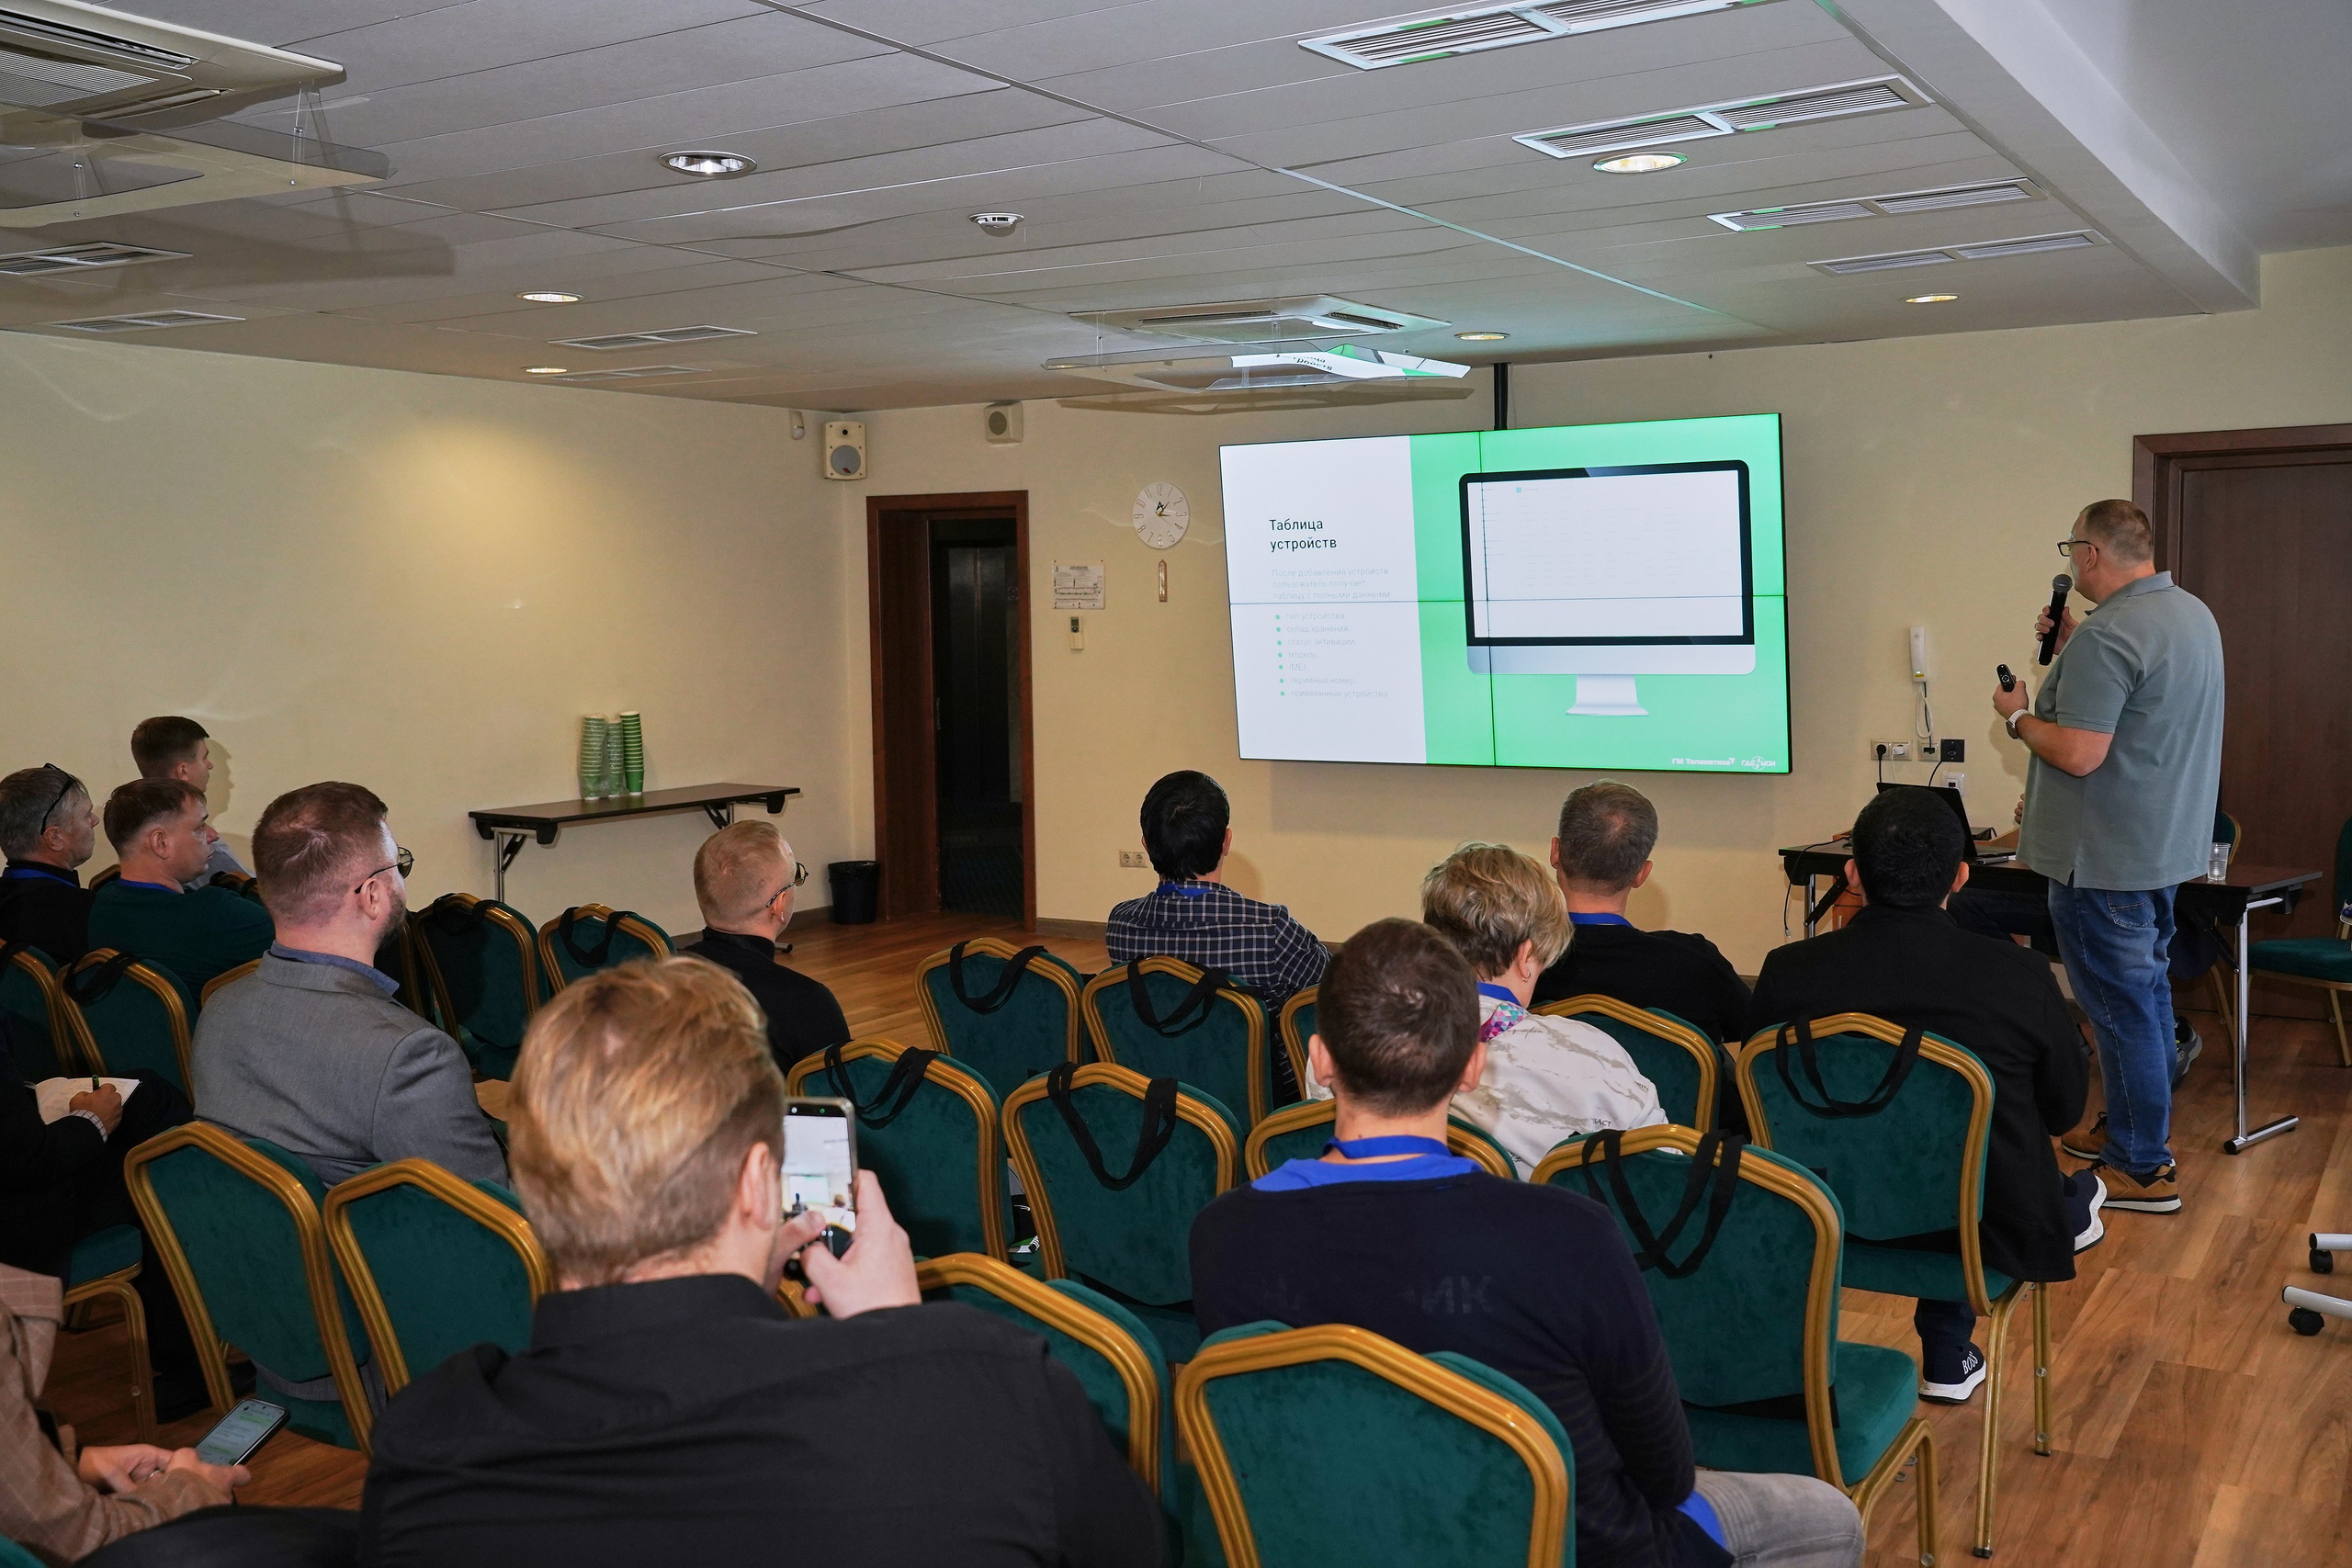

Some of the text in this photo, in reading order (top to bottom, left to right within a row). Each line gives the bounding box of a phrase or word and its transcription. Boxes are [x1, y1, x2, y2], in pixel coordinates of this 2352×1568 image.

[1269, 517, 1323, 532] Таблица
[1270, 536, 1338, 553] устройств
[1297, 569, 1346, 578] добавления
[1348, 568, 1389, 577] устройств
[1329, 580, 1365, 590] получает
[1273, 592, 1305, 600] таблицу
[1352, 591, 1391, 599] данными
[1286, 626, 1309, 634] склад
[1287, 638, 1312, 647] статус
[1290, 690, 1341, 698] привязанные
[1962, 1350, 1978, 1375] BOSS
